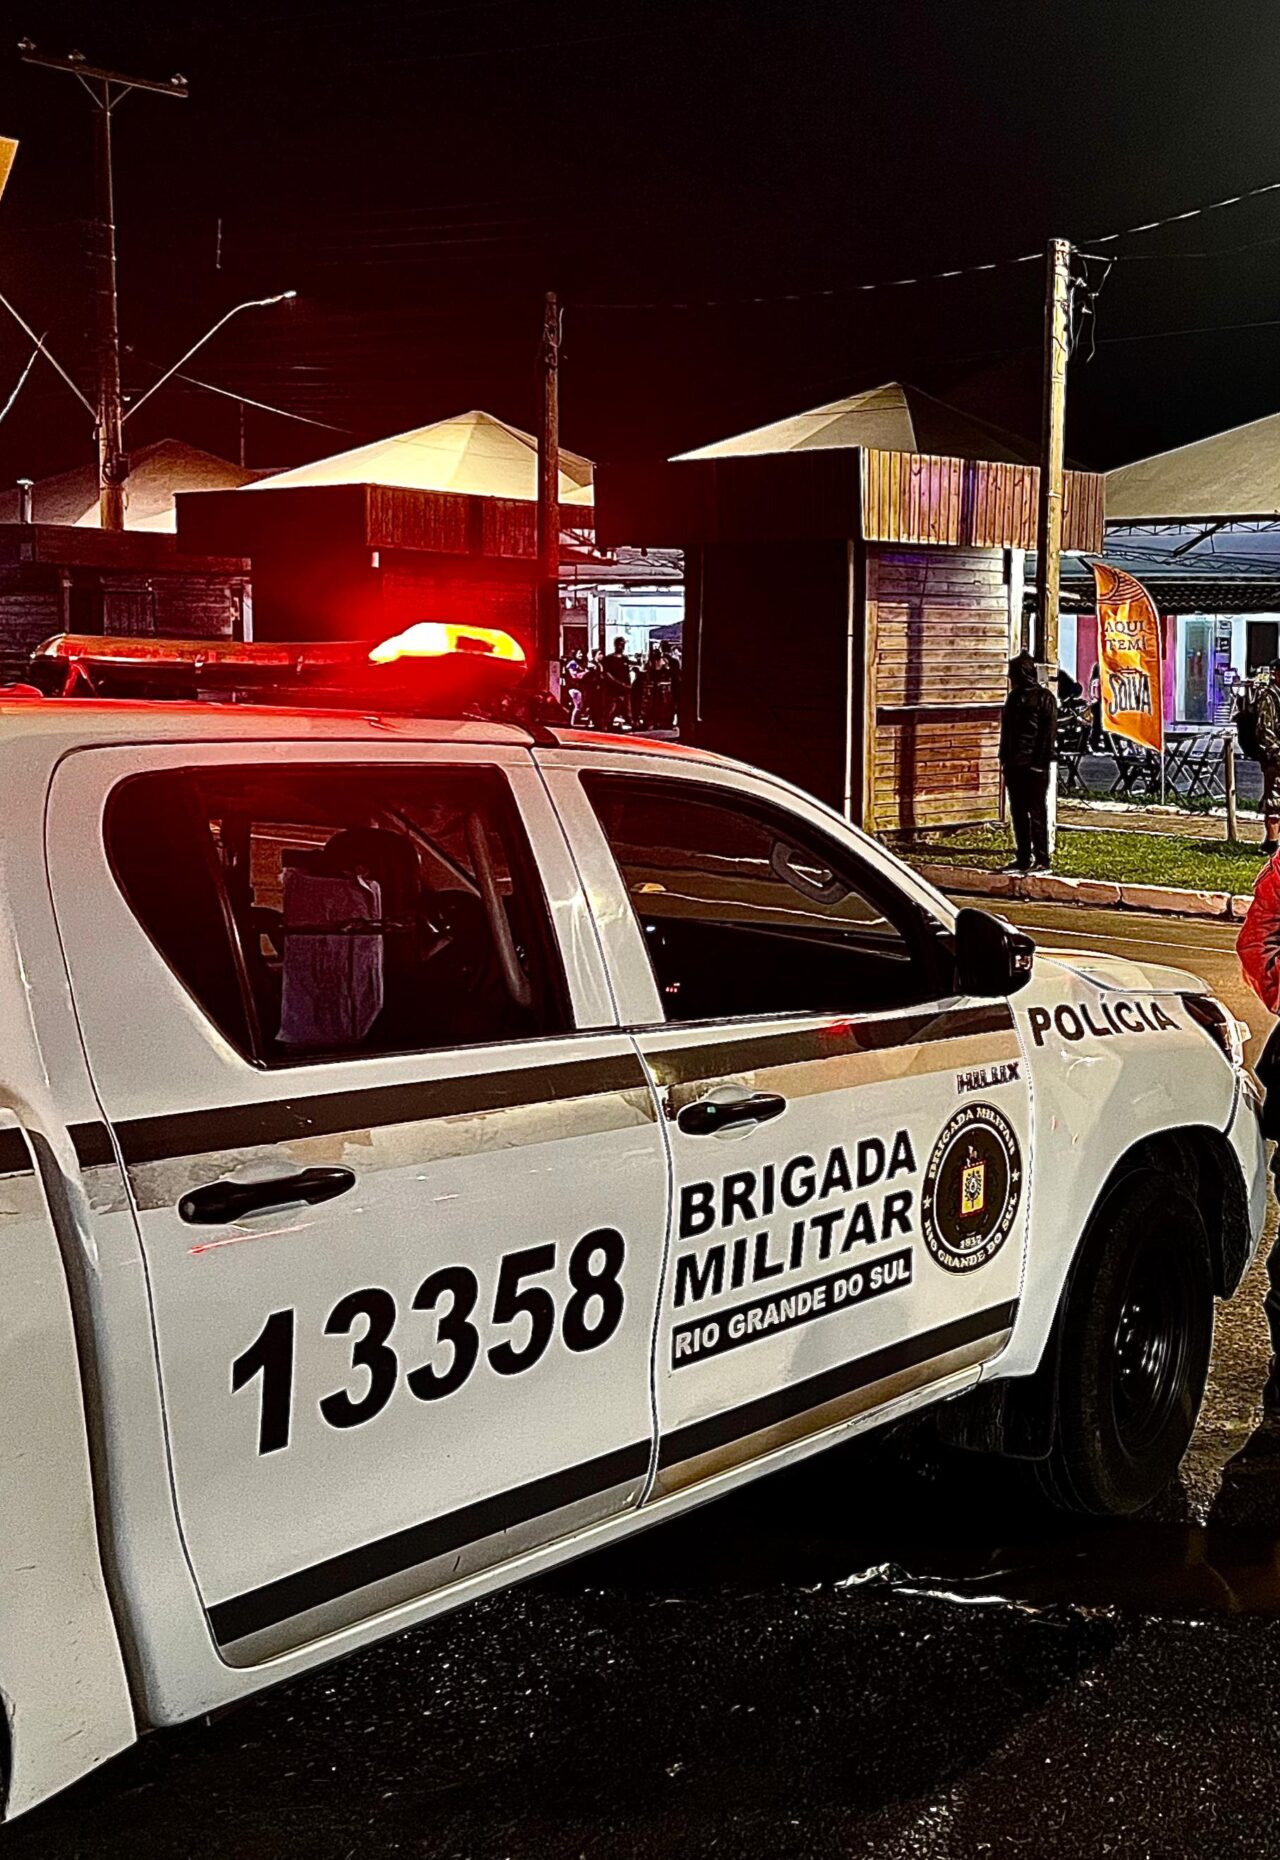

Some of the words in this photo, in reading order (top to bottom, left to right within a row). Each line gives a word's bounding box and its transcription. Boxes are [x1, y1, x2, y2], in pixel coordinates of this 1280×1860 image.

[1105, 620, 1144, 637] AQUI
[1105, 635, 1146, 650] TEM!
[1027, 993, 1181, 1046] POLÍCIA
[957, 1061, 1020, 1094] HILUX
[928, 1109, 974, 1179] BRIGADA
[976, 1107, 1015, 1155] MILITAR
[679, 1129, 917, 1240] BRIGADA
[673, 1189, 913, 1308] MILITAR
[924, 1219, 937, 1251] RIO
[938, 1249, 986, 1268] GRANDE
[986, 1232, 1002, 1254] DO
[1002, 1193, 1017, 1231] SUL
[231, 1227, 626, 1456] 13358
[675, 1322, 720, 1358] RIO
[728, 1286, 826, 1338] GRANDE
[833, 1273, 863, 1304] DO
[870, 1258, 910, 1289] SUL
